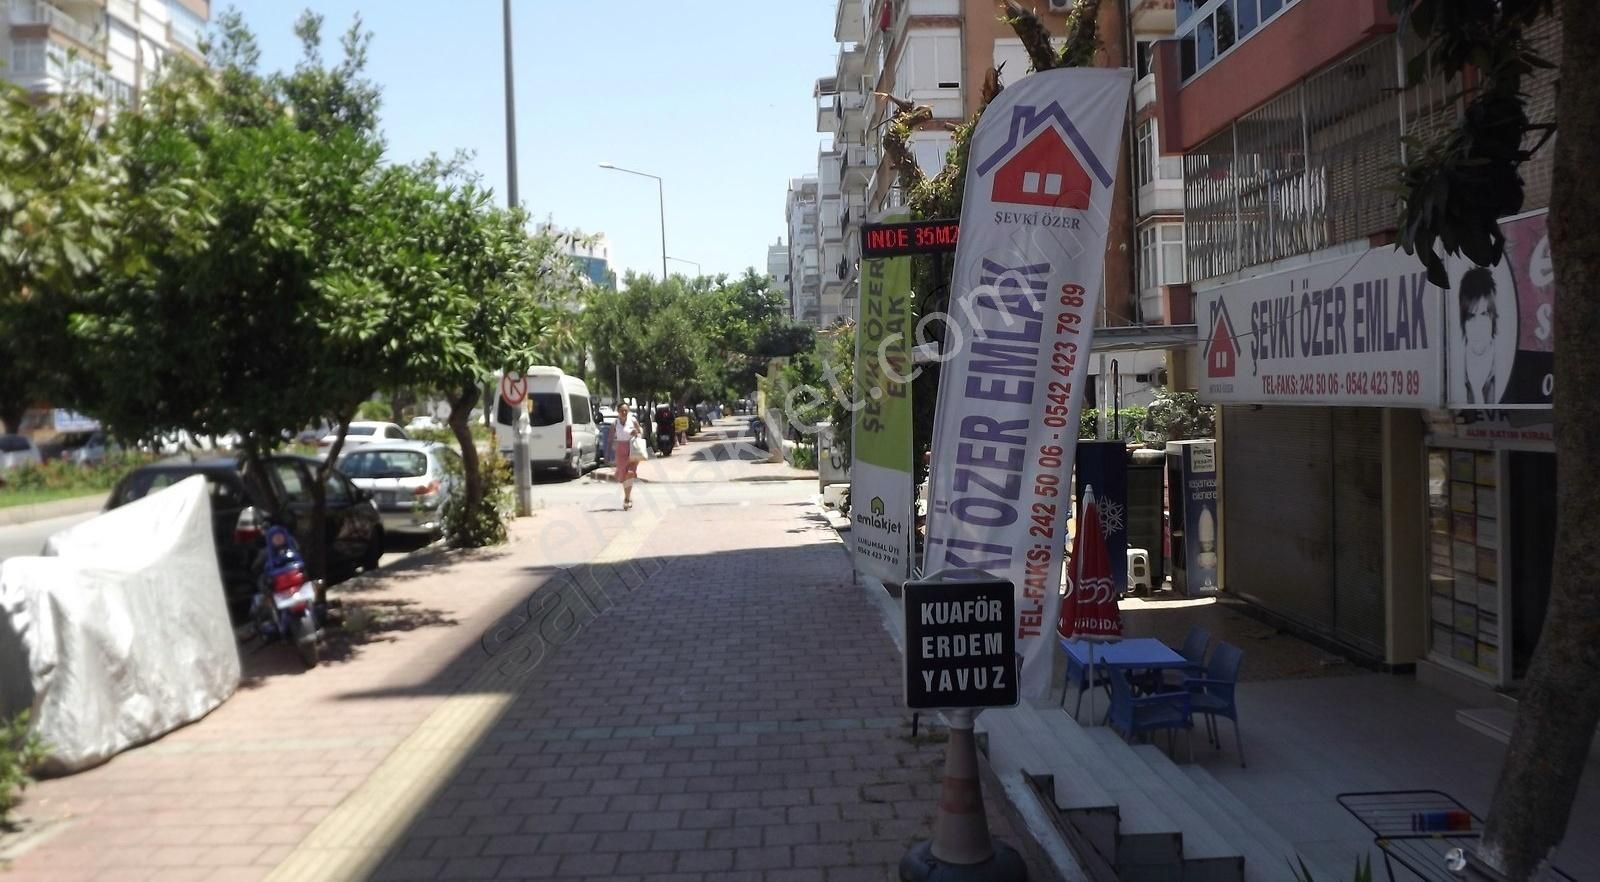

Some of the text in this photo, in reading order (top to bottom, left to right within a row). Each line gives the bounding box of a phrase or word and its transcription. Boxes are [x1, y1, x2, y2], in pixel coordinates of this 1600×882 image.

[994, 211, 1081, 231] ŞEVKİ ÖZER
[864, 260, 884, 341] ÖZER
[1060, 283, 1086, 308] 89
[965, 257, 1051, 404] EMLAK
[1056, 312, 1082, 335] 79
[1251, 271, 1428, 376] ŞEVKİ ÖZER EMLAK
[1051, 341, 1078, 377] 423
[1262, 374, 1298, 395] TEL-FAKS:
[1300, 374, 1314, 395] 242
[1316, 373, 1326, 395] 50
[1328, 373, 1339, 394] 06
[1346, 371, 1368, 395] 0542
[1370, 370, 1388, 395] 423
[1391, 370, 1403, 395] 79
[1406, 370, 1420, 395] 89
[1044, 381, 1072, 428] 0542
[1038, 445, 1064, 468] 06
[935, 415, 1030, 527] ÖZER
[1034, 474, 1060, 498] 50
[857, 514, 901, 534] emlakjet
[1029, 502, 1057, 539] 242
[1018, 544, 1051, 640] TEL-FAKS:
[921, 595, 1002, 625] KUAFÖR
[922, 632, 1003, 659] ERDEM
[921, 666, 1006, 692] YAVUZ
